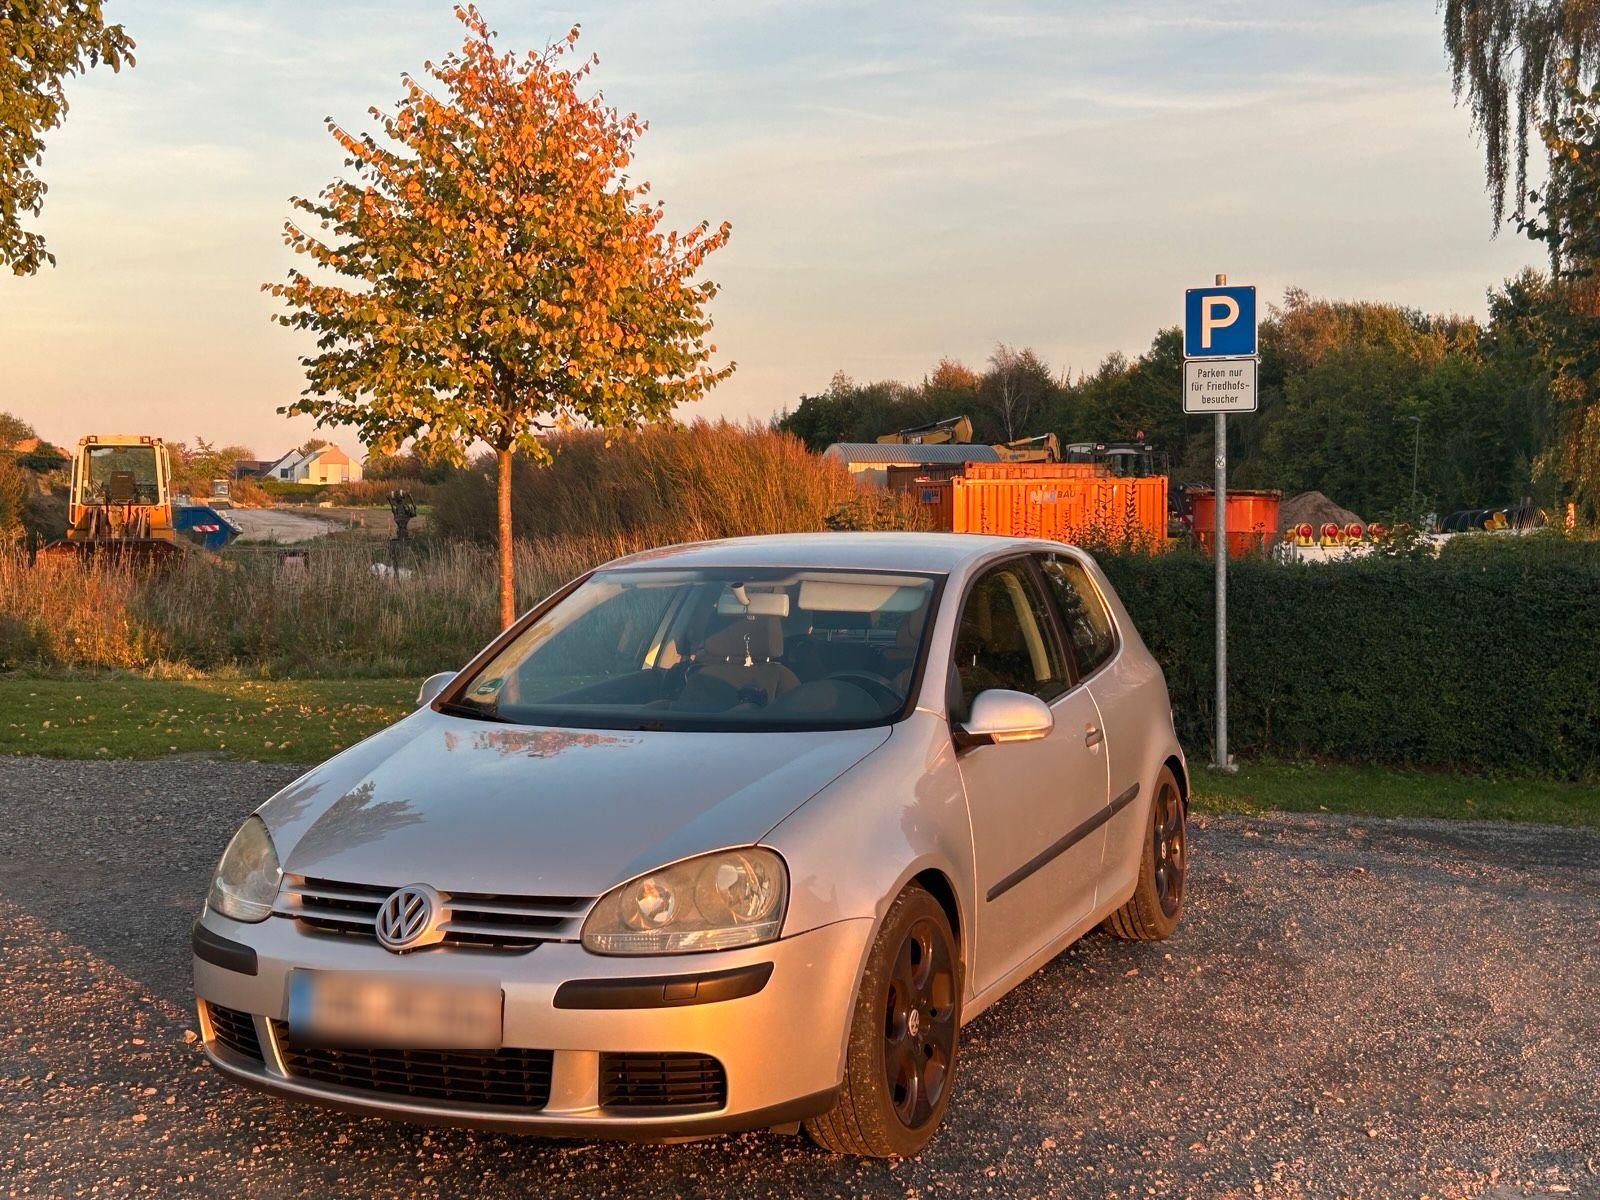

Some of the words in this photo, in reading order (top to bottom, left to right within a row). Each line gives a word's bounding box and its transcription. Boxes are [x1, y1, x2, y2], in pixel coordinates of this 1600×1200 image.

[1202, 295, 1240, 348] P
[1198, 368, 1225, 378] Parken
[1229, 369, 1243, 377] nur
[1191, 381, 1203, 392] für
[1207, 381, 1250, 391] Friedhofs-
[1201, 394, 1239, 404] besucher
[379, 889, 429, 943] VW
